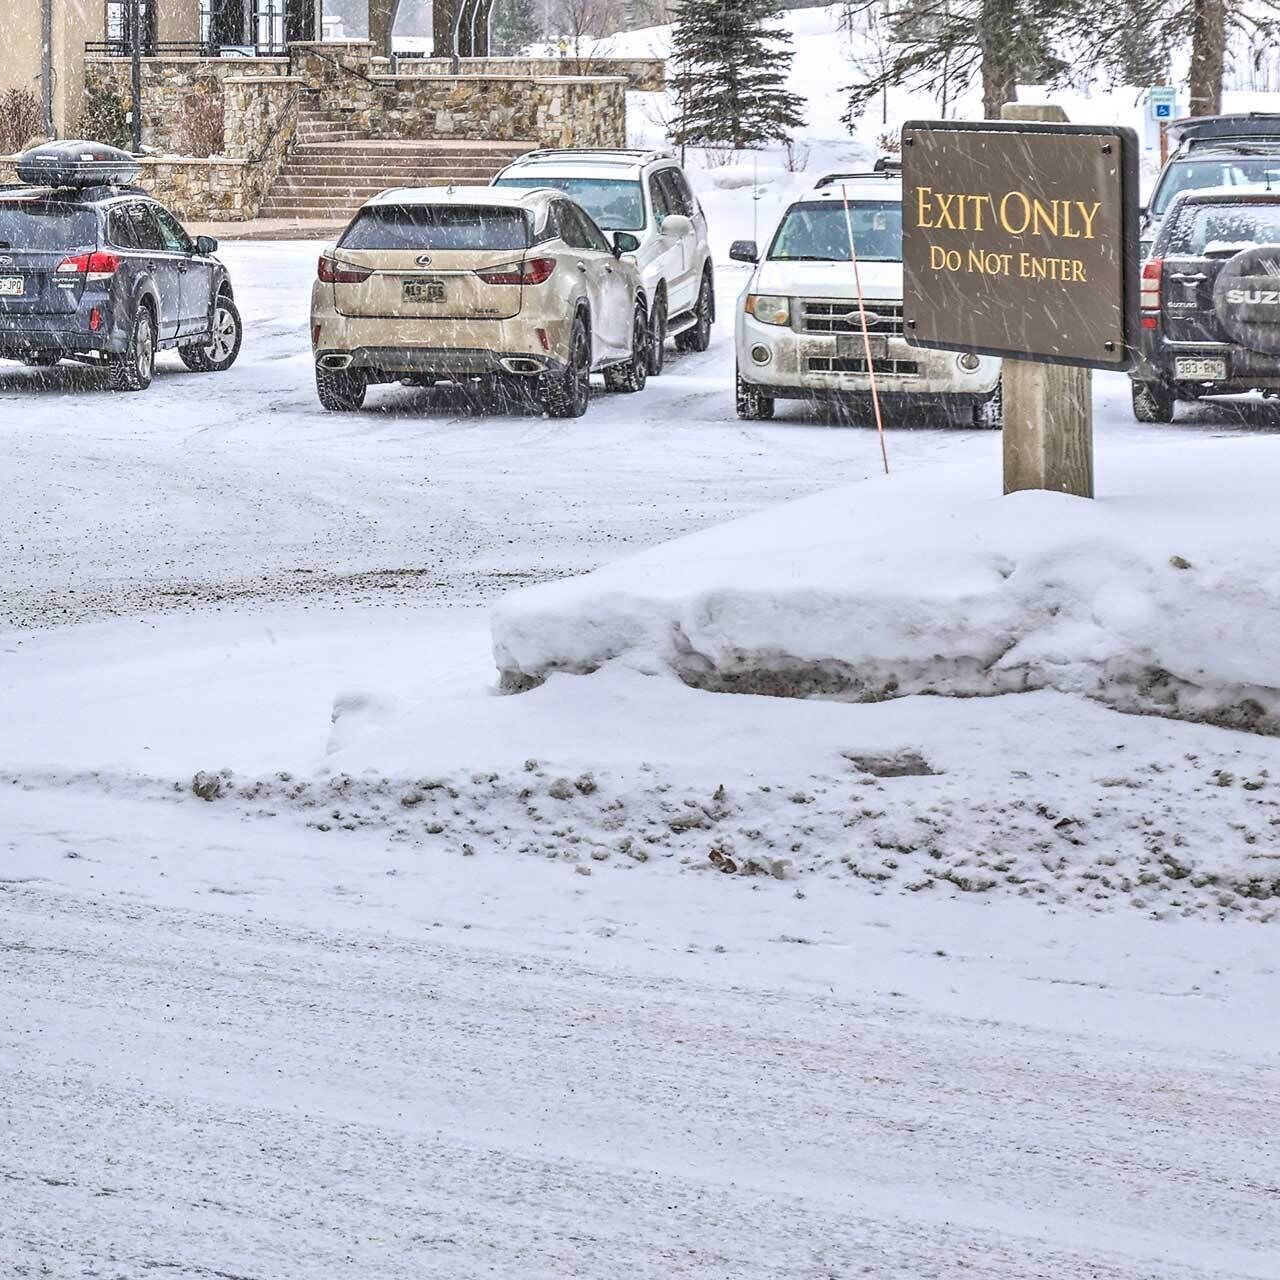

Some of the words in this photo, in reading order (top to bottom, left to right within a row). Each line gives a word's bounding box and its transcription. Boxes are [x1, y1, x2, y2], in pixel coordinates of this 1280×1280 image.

[915, 186, 989, 231] EXIT
[1000, 191, 1102, 240] ONLY
[930, 245, 961, 272] DO
[968, 249, 1013, 276] NOT
[1020, 252, 1087, 282] ENTER
[1226, 289, 1280, 305] SUZ
